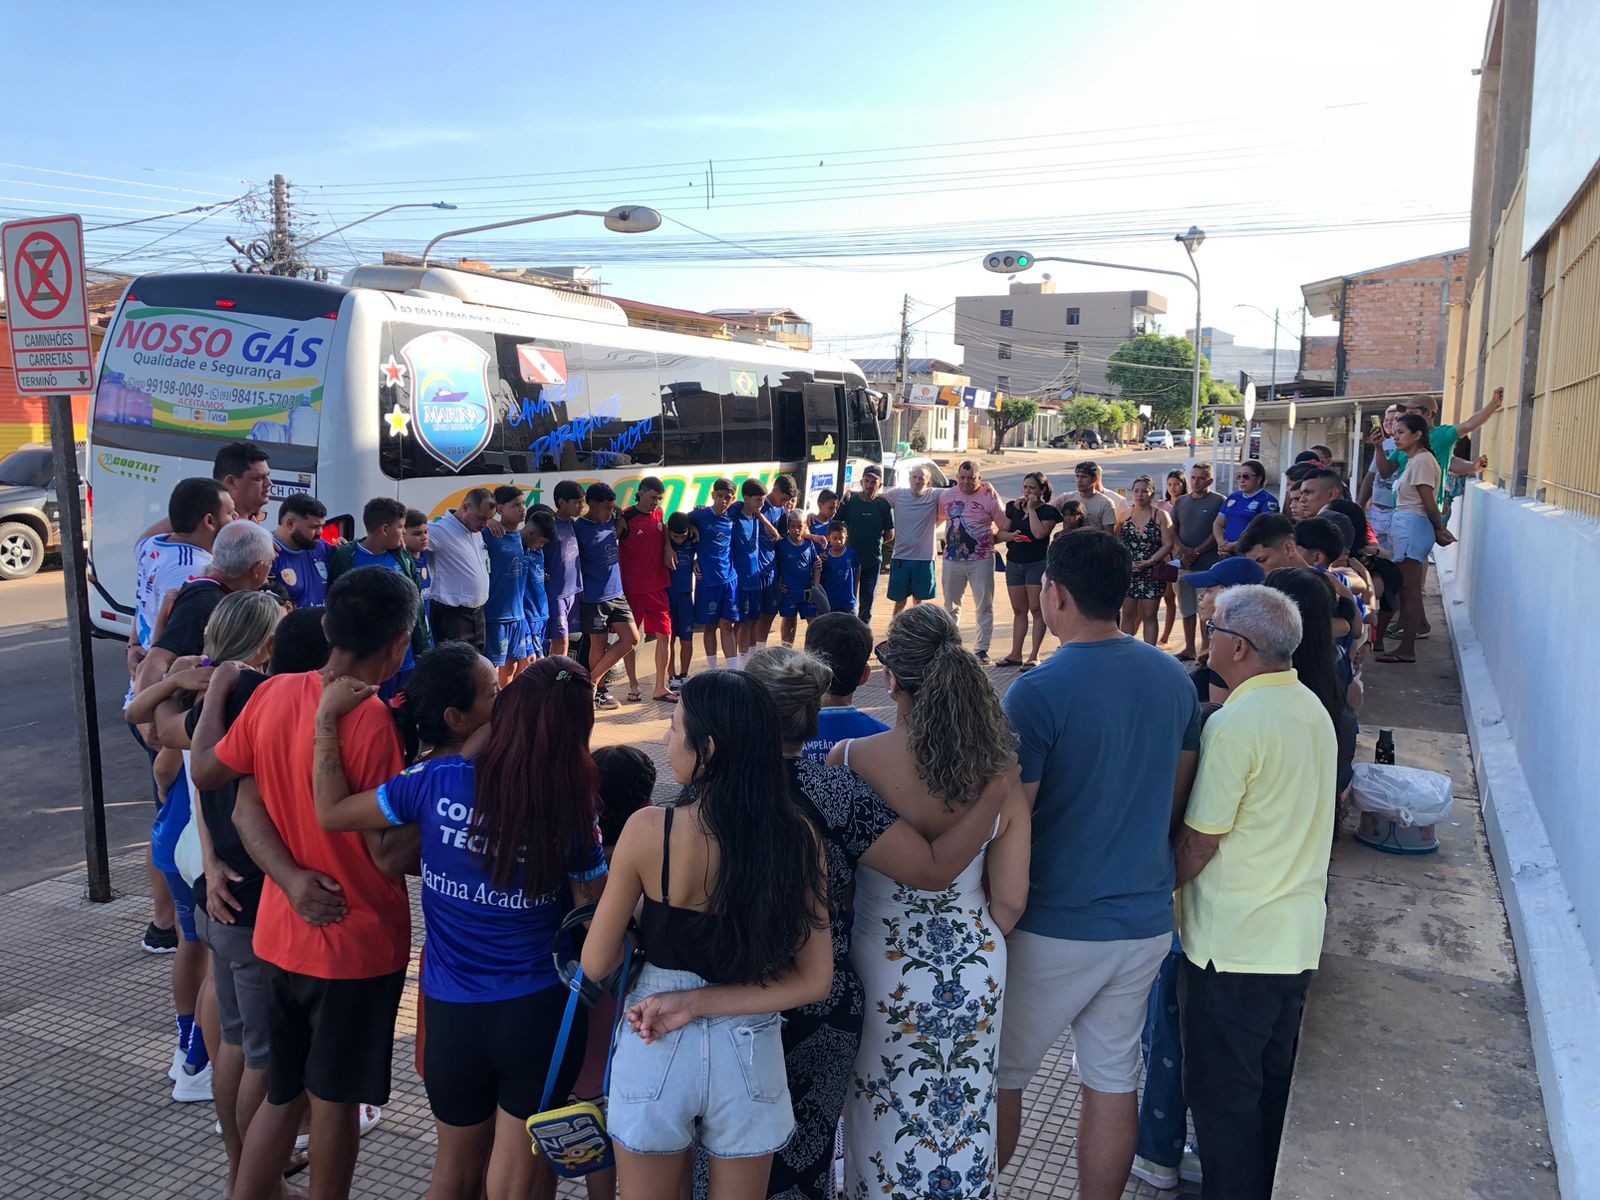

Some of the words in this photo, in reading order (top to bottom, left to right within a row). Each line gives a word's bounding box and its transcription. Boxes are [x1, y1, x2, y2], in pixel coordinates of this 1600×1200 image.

[24, 331, 74, 347] CAMINHÕES
[116, 320, 232, 358] NOSSO
[242, 327, 324, 368] GÁS
[29, 353, 73, 367] CARRETAS
[133, 352, 196, 370] Qualidade
[199, 362, 208, 371] e
[211, 360, 282, 381] Segurança
[146, 378, 204, 398] 99198-0049
[232, 388, 296, 409] 98415-5703
[178, 398, 225, 410] ACEITAMOS
[211, 413, 227, 423] VISA
[423, 405, 482, 424] MARINA
[447, 446, 466, 455] 2017
[802, 739, 834, 751] AMPEÃO
